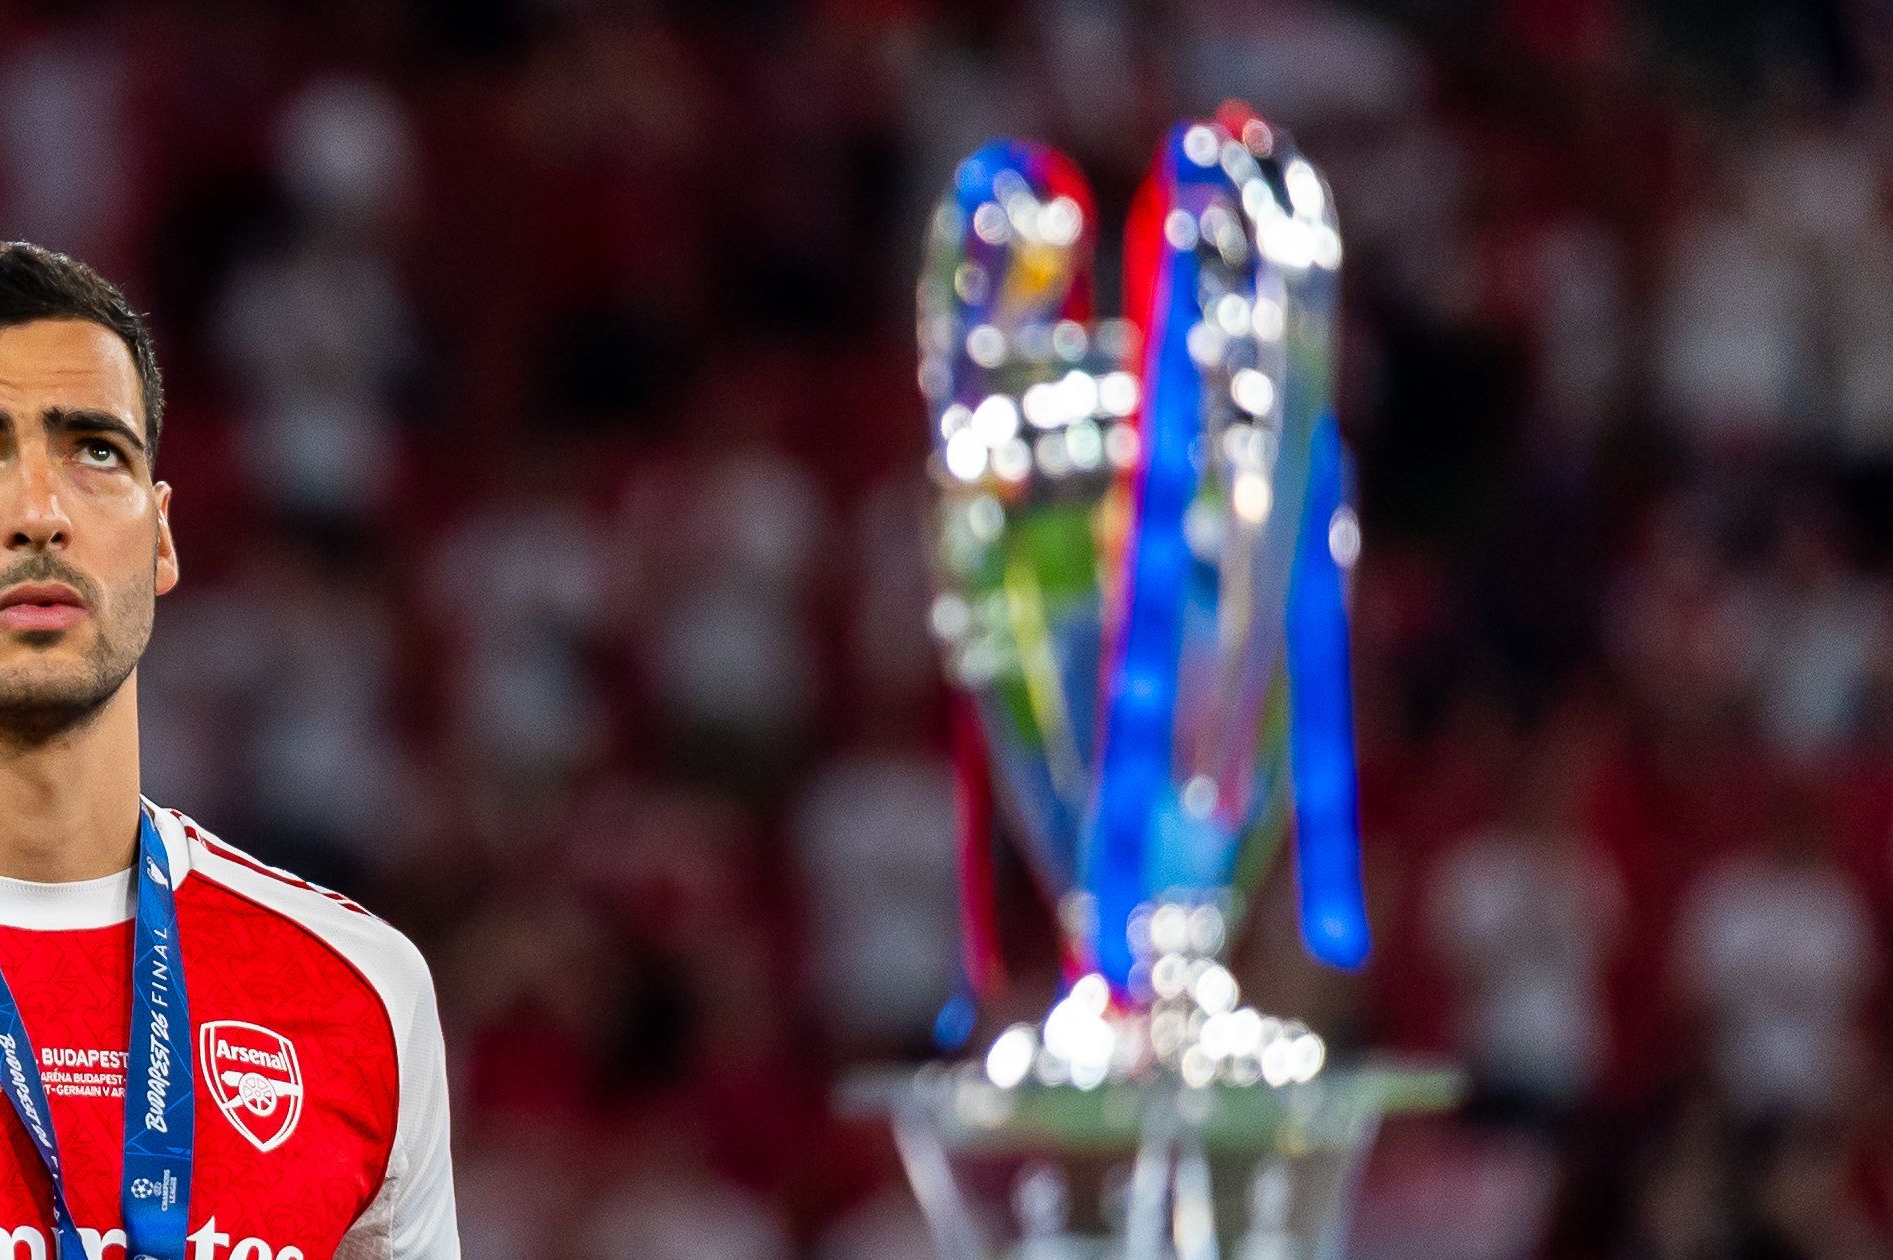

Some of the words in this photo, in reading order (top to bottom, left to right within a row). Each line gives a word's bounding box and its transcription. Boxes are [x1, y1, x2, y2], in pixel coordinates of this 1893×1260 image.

[151, 926, 169, 1008] FINAL
[41, 1047, 129, 1069] BUDAPEST
[215, 1039, 289, 1072] Arsenal
[44, 1084, 102, 1098] T-GERMAIN
